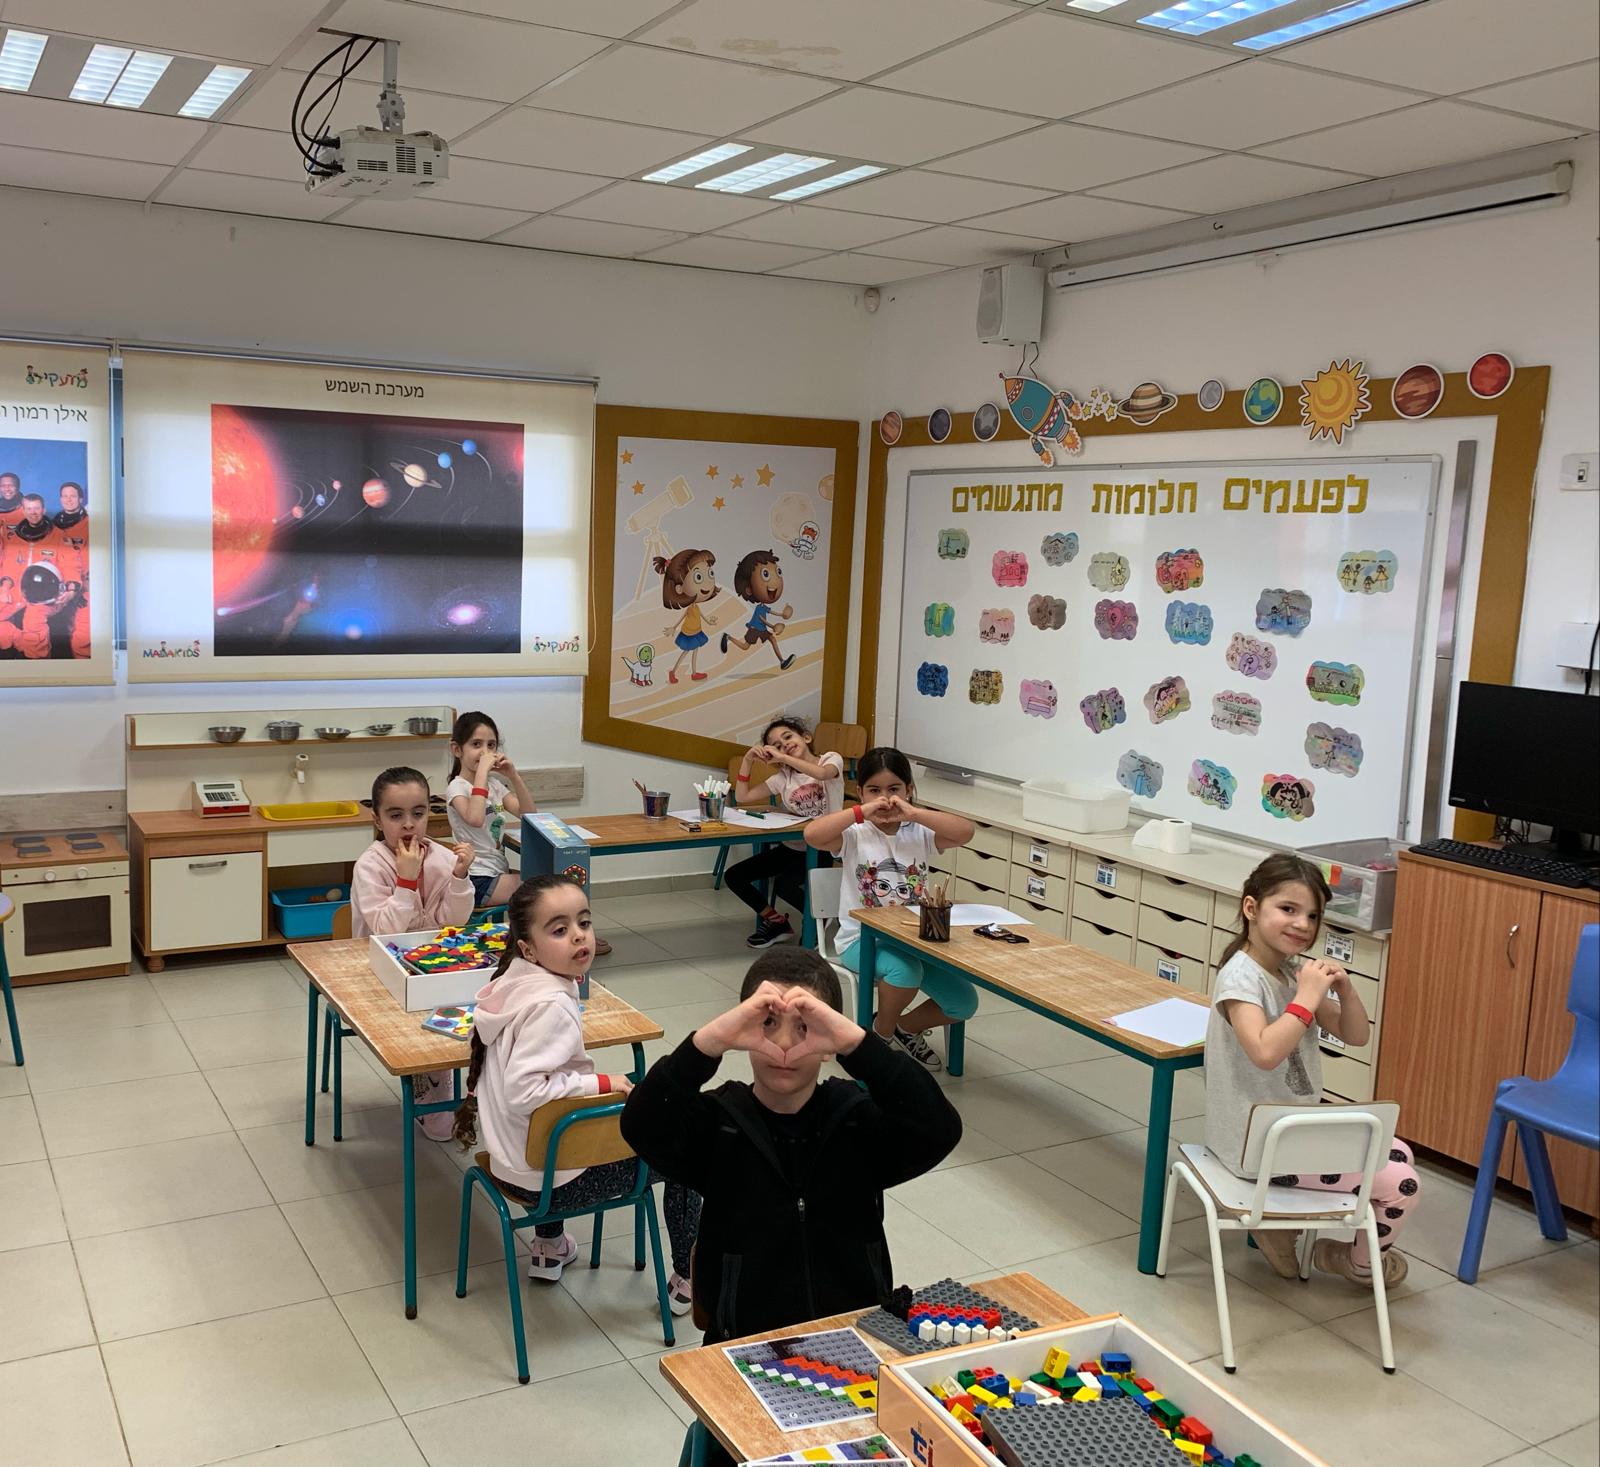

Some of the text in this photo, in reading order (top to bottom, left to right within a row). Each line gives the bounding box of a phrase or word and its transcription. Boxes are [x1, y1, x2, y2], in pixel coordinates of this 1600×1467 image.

[325, 379, 424, 398] מערכת השמש
[12, 405, 49, 422] רמון
[54, 404, 88, 424] אילן
[952, 474, 1370, 516] לפעמים חלומות מתגשמים
